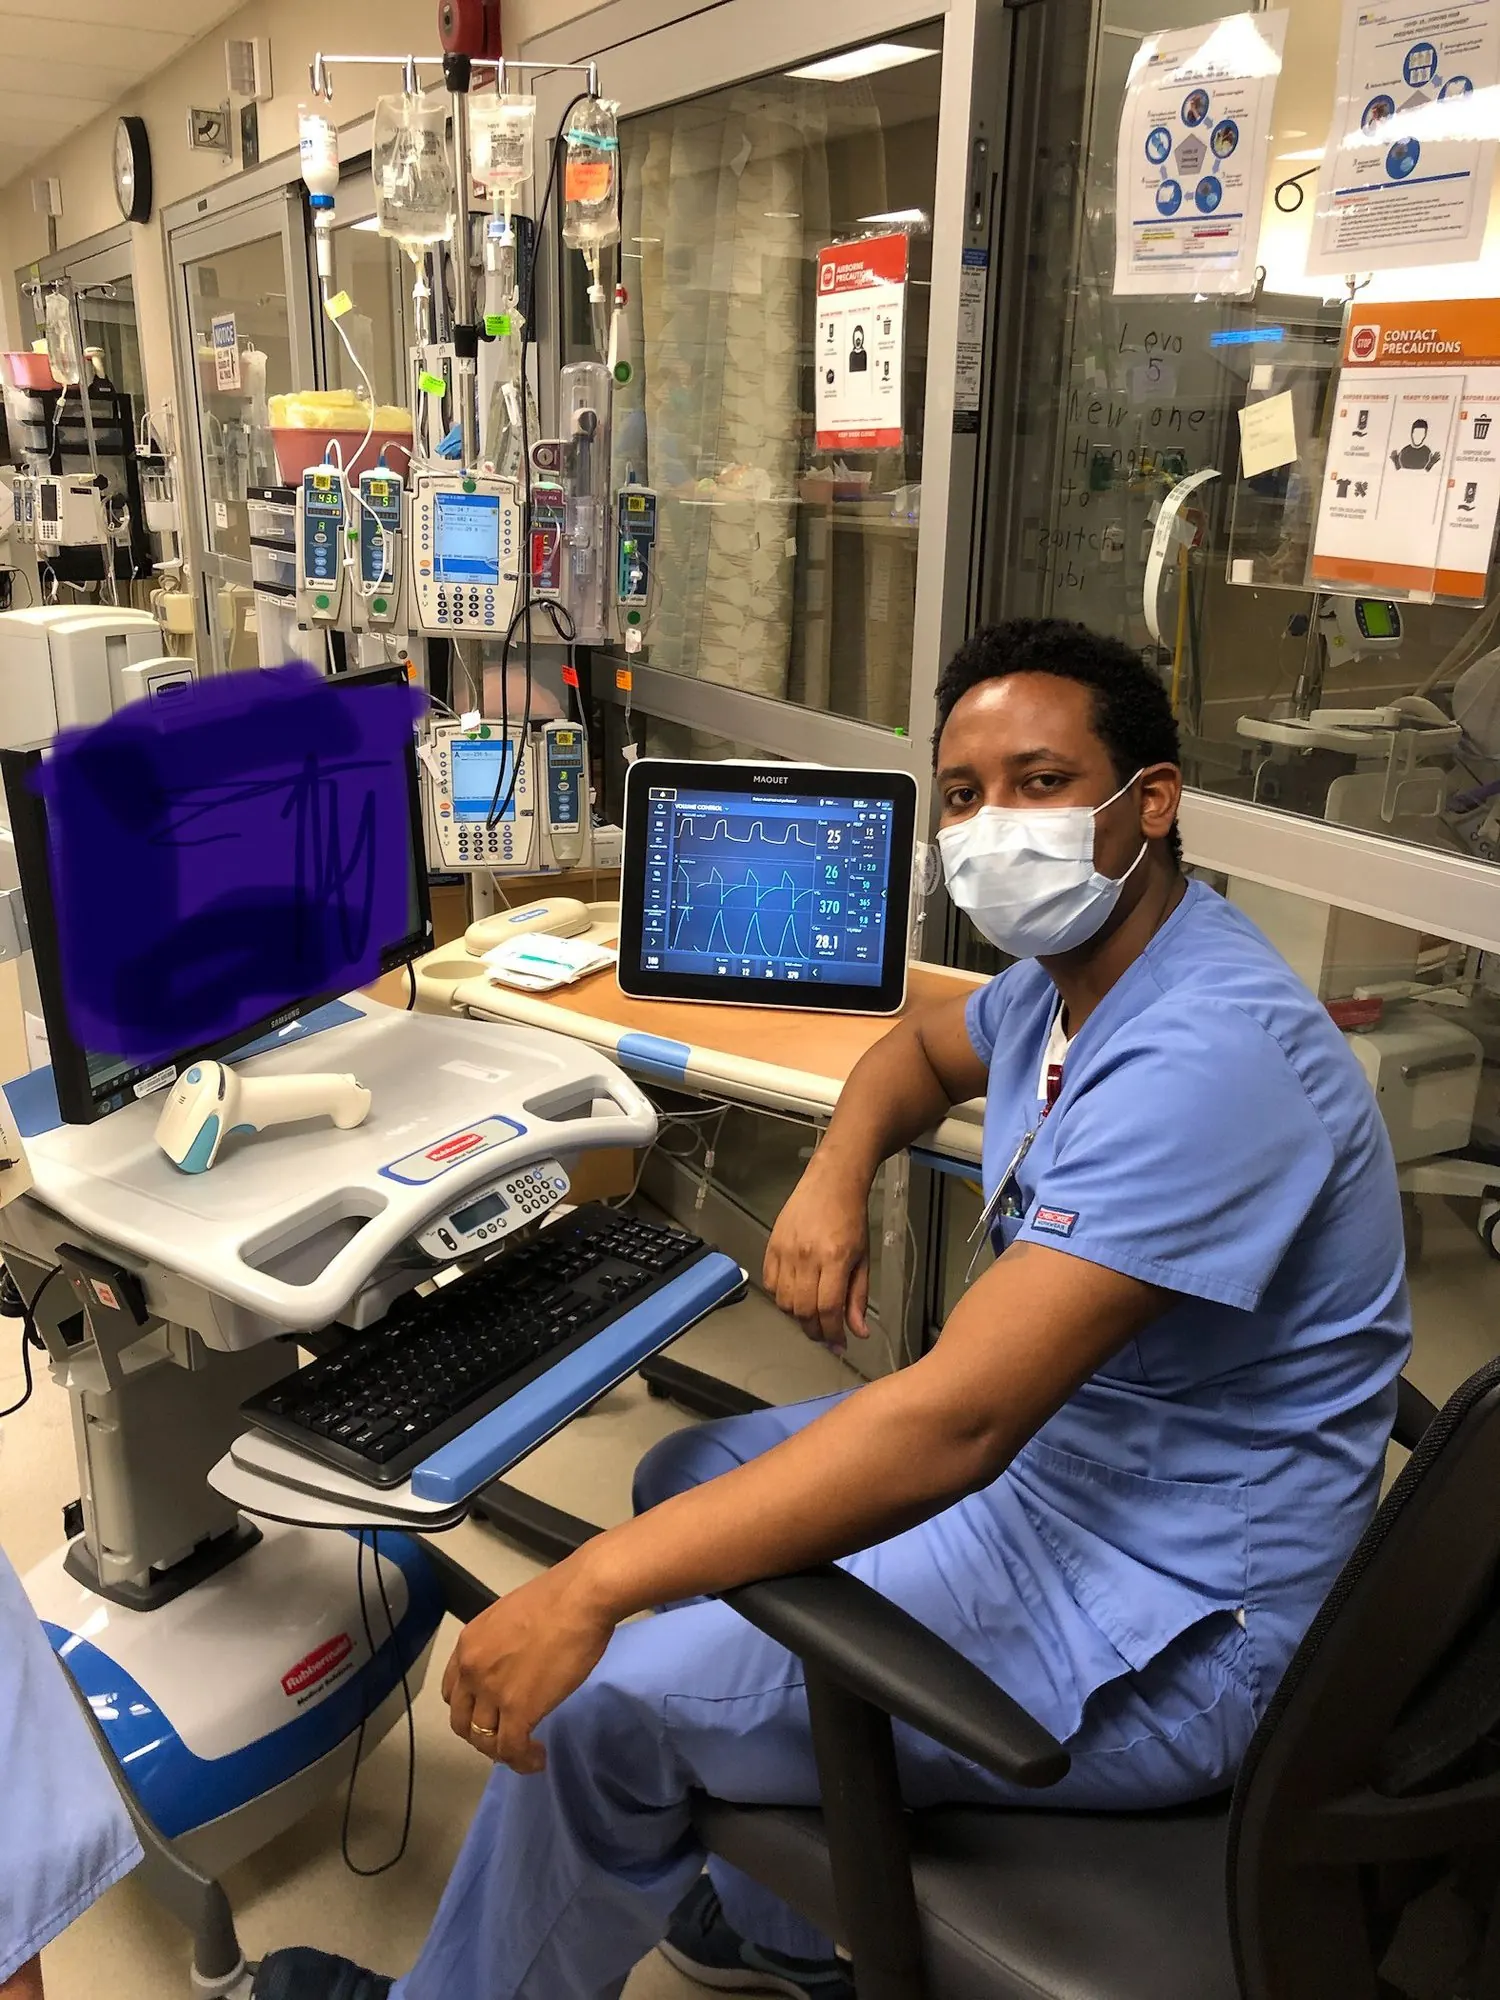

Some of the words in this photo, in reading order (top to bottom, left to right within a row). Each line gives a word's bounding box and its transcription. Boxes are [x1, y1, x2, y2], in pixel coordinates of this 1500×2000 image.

[1384, 328, 1437, 342] CONTACT
[1356, 338, 1372, 349] STOP
[1381, 341, 1461, 355] PRECAUTIONS
[1149, 357, 1164, 383] 5
[1150, 405, 1206, 432] one
[753, 775, 789, 785] MAQUET
[827, 829, 841, 844] 25
[866, 827, 874, 836] 12
[825, 864, 839, 879] 26
[819, 899, 840, 914] 370
[815, 934, 838, 949] 28.1
[270, 1007, 301, 1029] SAMSUNG
